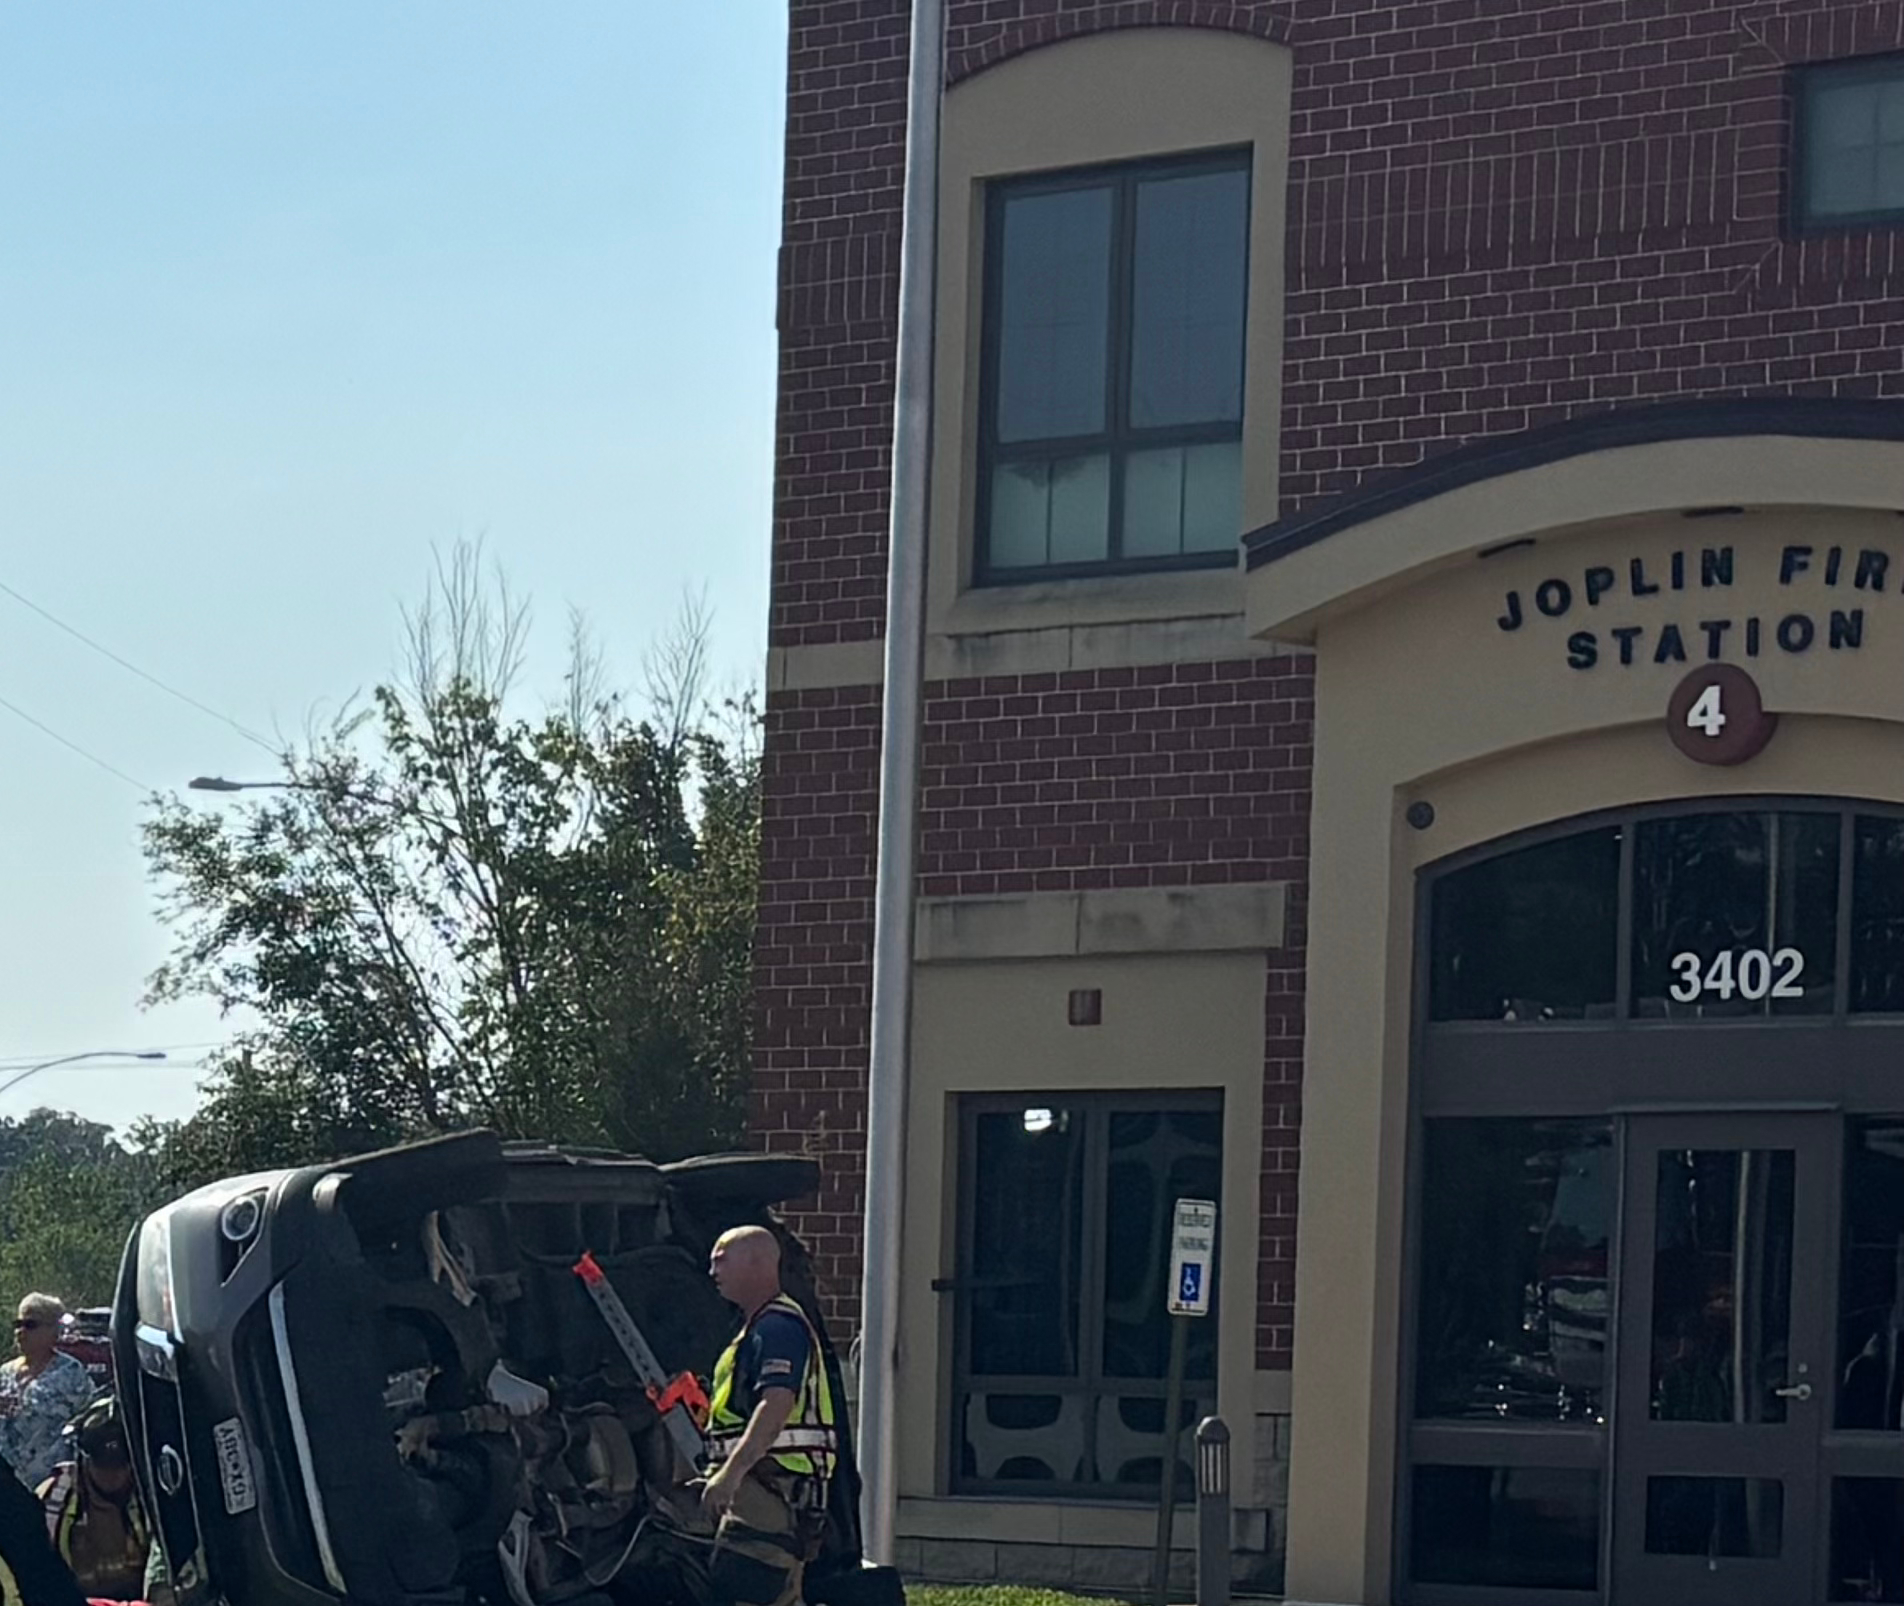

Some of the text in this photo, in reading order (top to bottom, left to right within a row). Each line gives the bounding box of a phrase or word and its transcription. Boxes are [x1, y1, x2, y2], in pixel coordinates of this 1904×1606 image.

[1497, 545, 1904, 631] JOPLIN FIR
[1567, 609, 1864, 670] STATION
[1687, 684, 1726, 737] 4
[1669, 947, 1804, 1002] 3402
